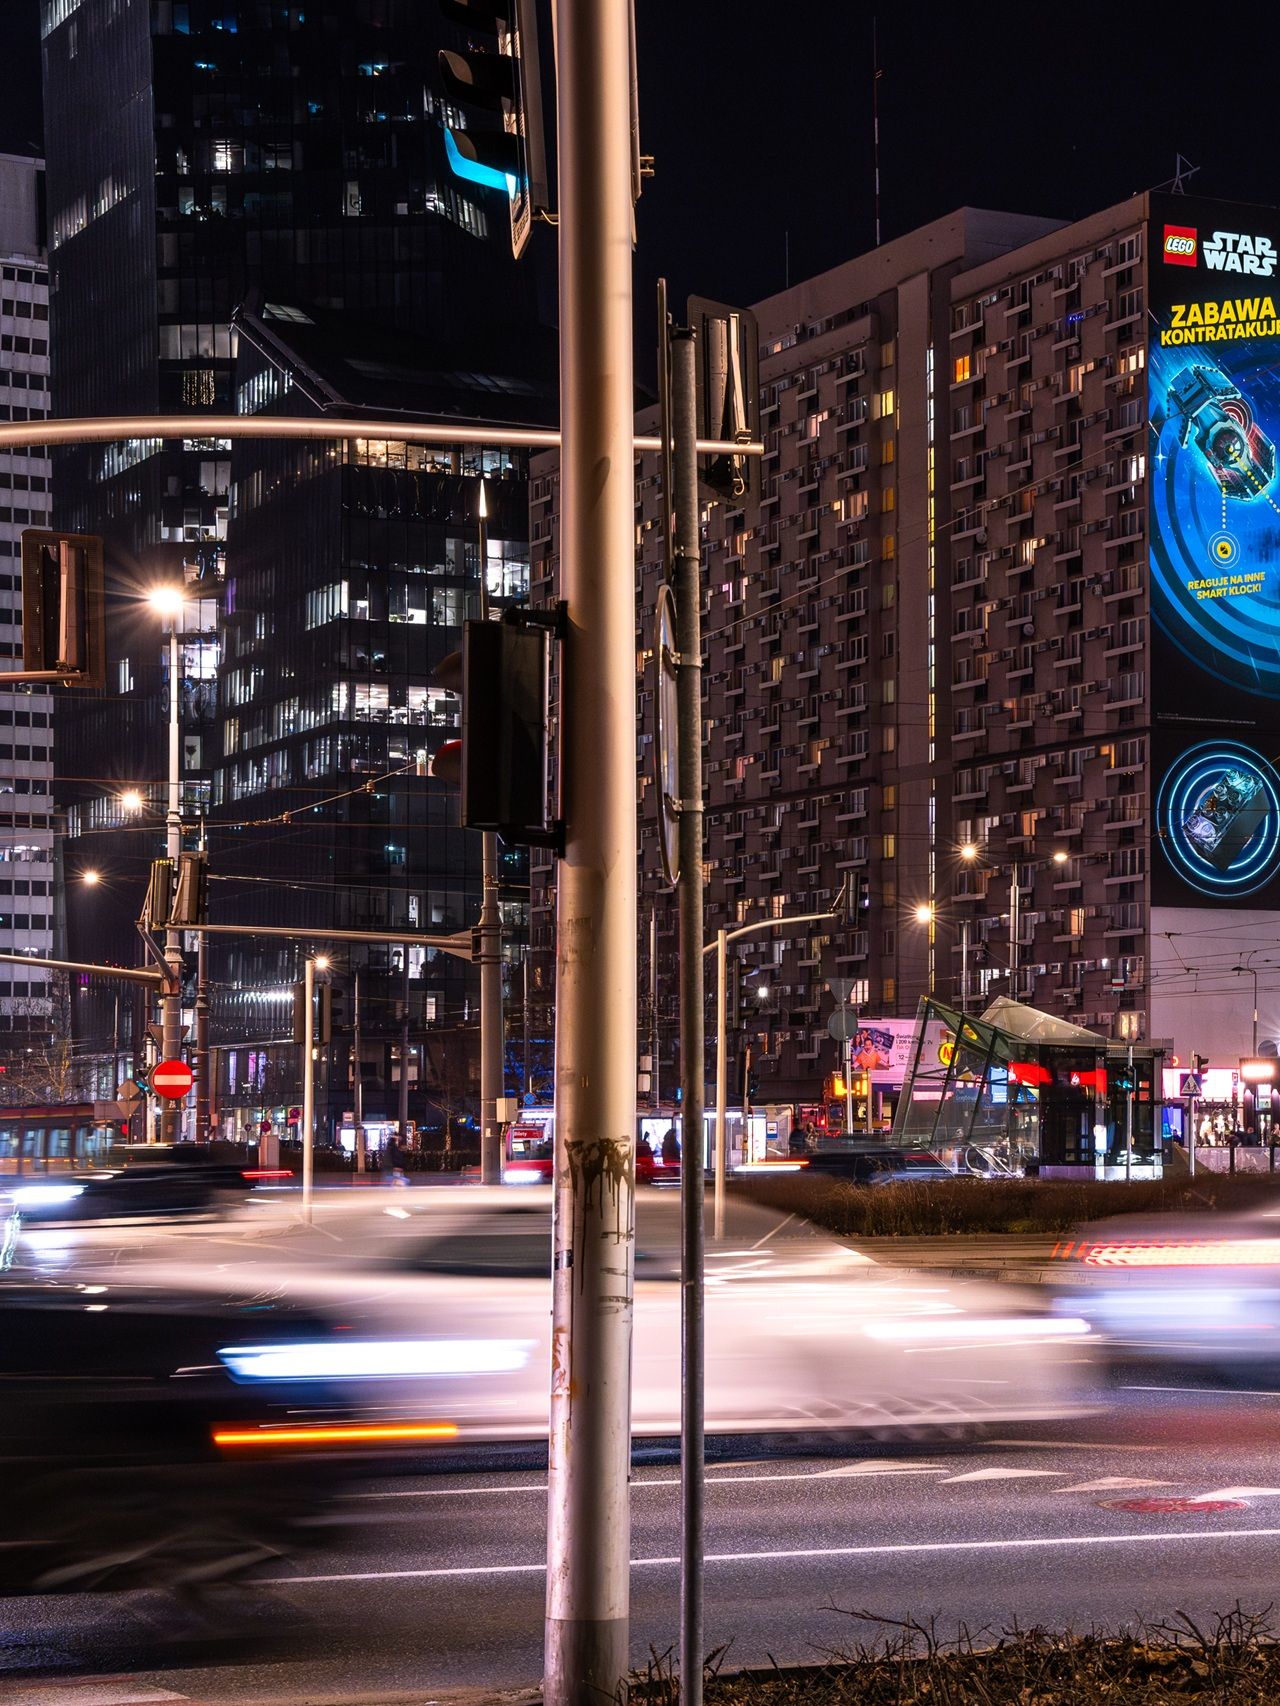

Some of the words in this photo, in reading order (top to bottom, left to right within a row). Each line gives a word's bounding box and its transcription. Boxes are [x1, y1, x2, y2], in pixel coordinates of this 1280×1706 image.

[1165, 236, 1196, 255] LEGO
[1203, 231, 1277, 258] STAR
[1203, 249, 1277, 277] WARS
[1171, 296, 1276, 328] ZABAWA
[1187, 575, 1229, 591] REAGUJE
[1229, 573, 1243, 585] NA
[1244, 571, 1266, 584] INNE
[1196, 586, 1227, 601] SMART
[1229, 583, 1262, 597] KLOCKI
